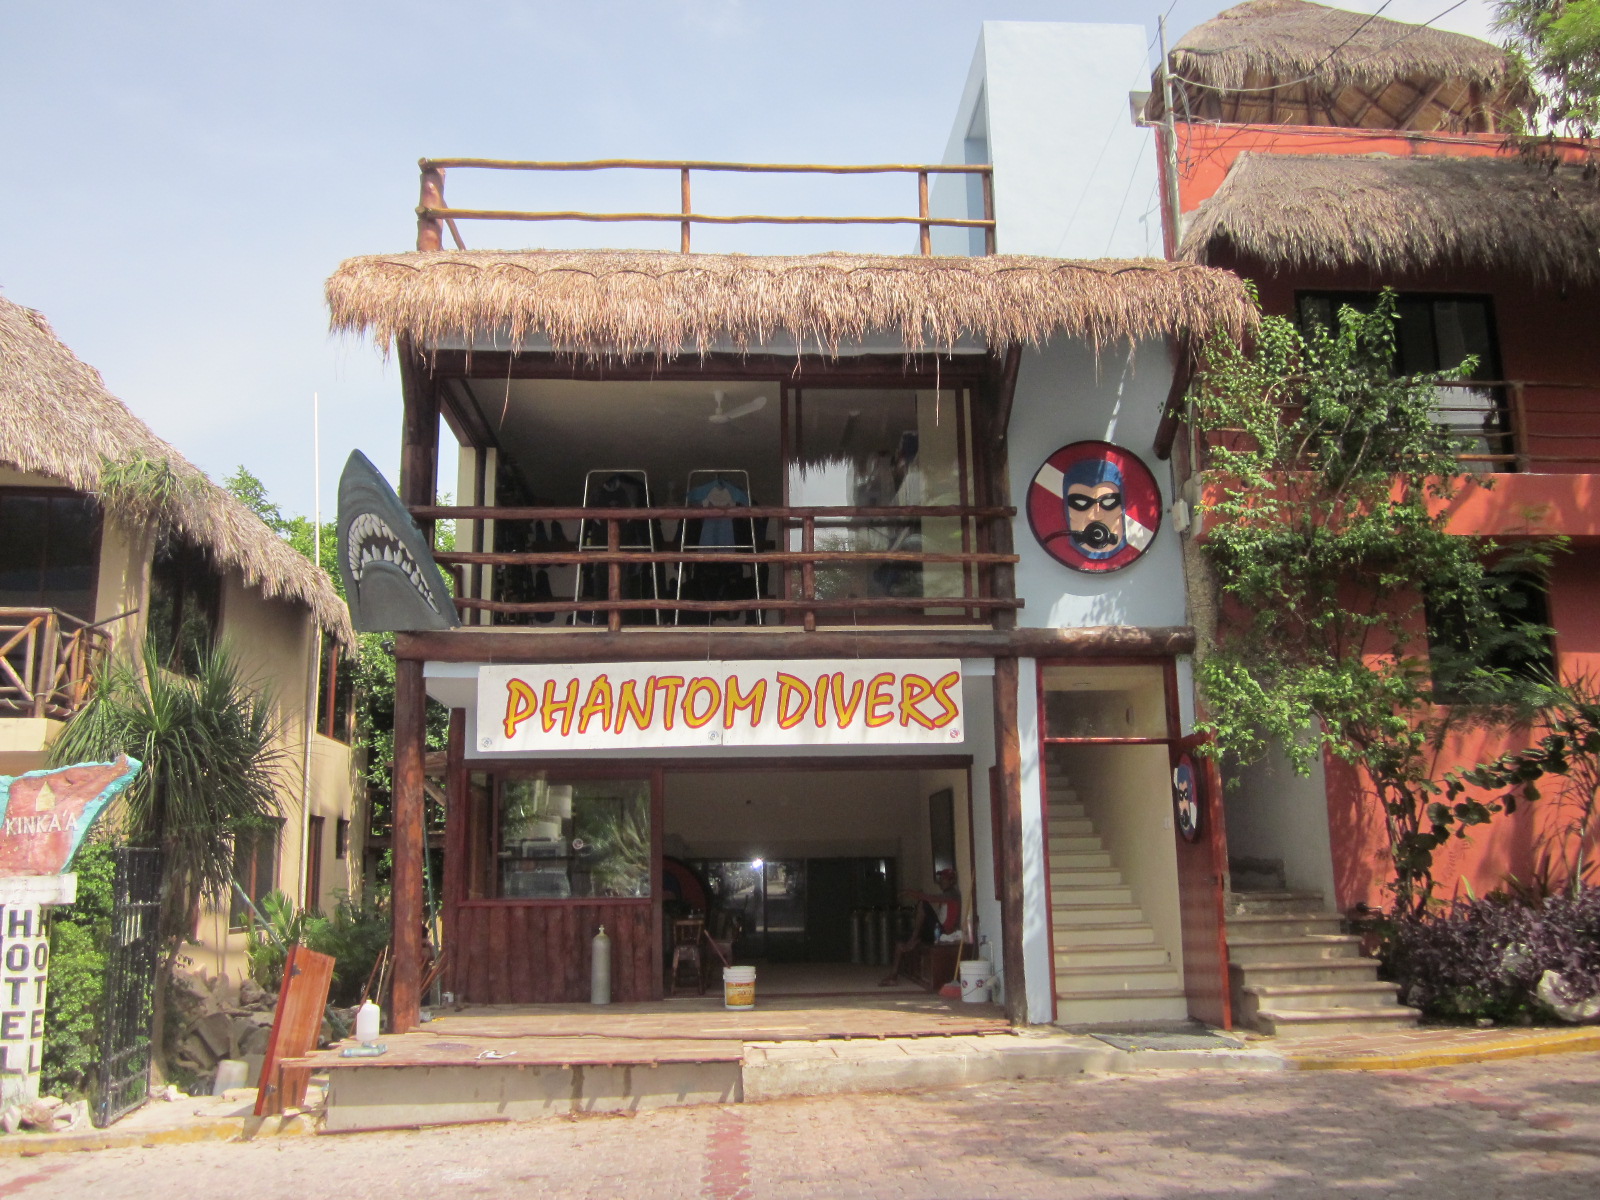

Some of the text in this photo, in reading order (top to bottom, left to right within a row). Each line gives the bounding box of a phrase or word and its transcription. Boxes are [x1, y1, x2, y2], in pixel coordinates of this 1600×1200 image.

[503, 671, 960, 738] PHANTOM DIVERS
[0, 909, 33, 1075] HOTEL
[28, 908, 51, 1074] HOTEL
